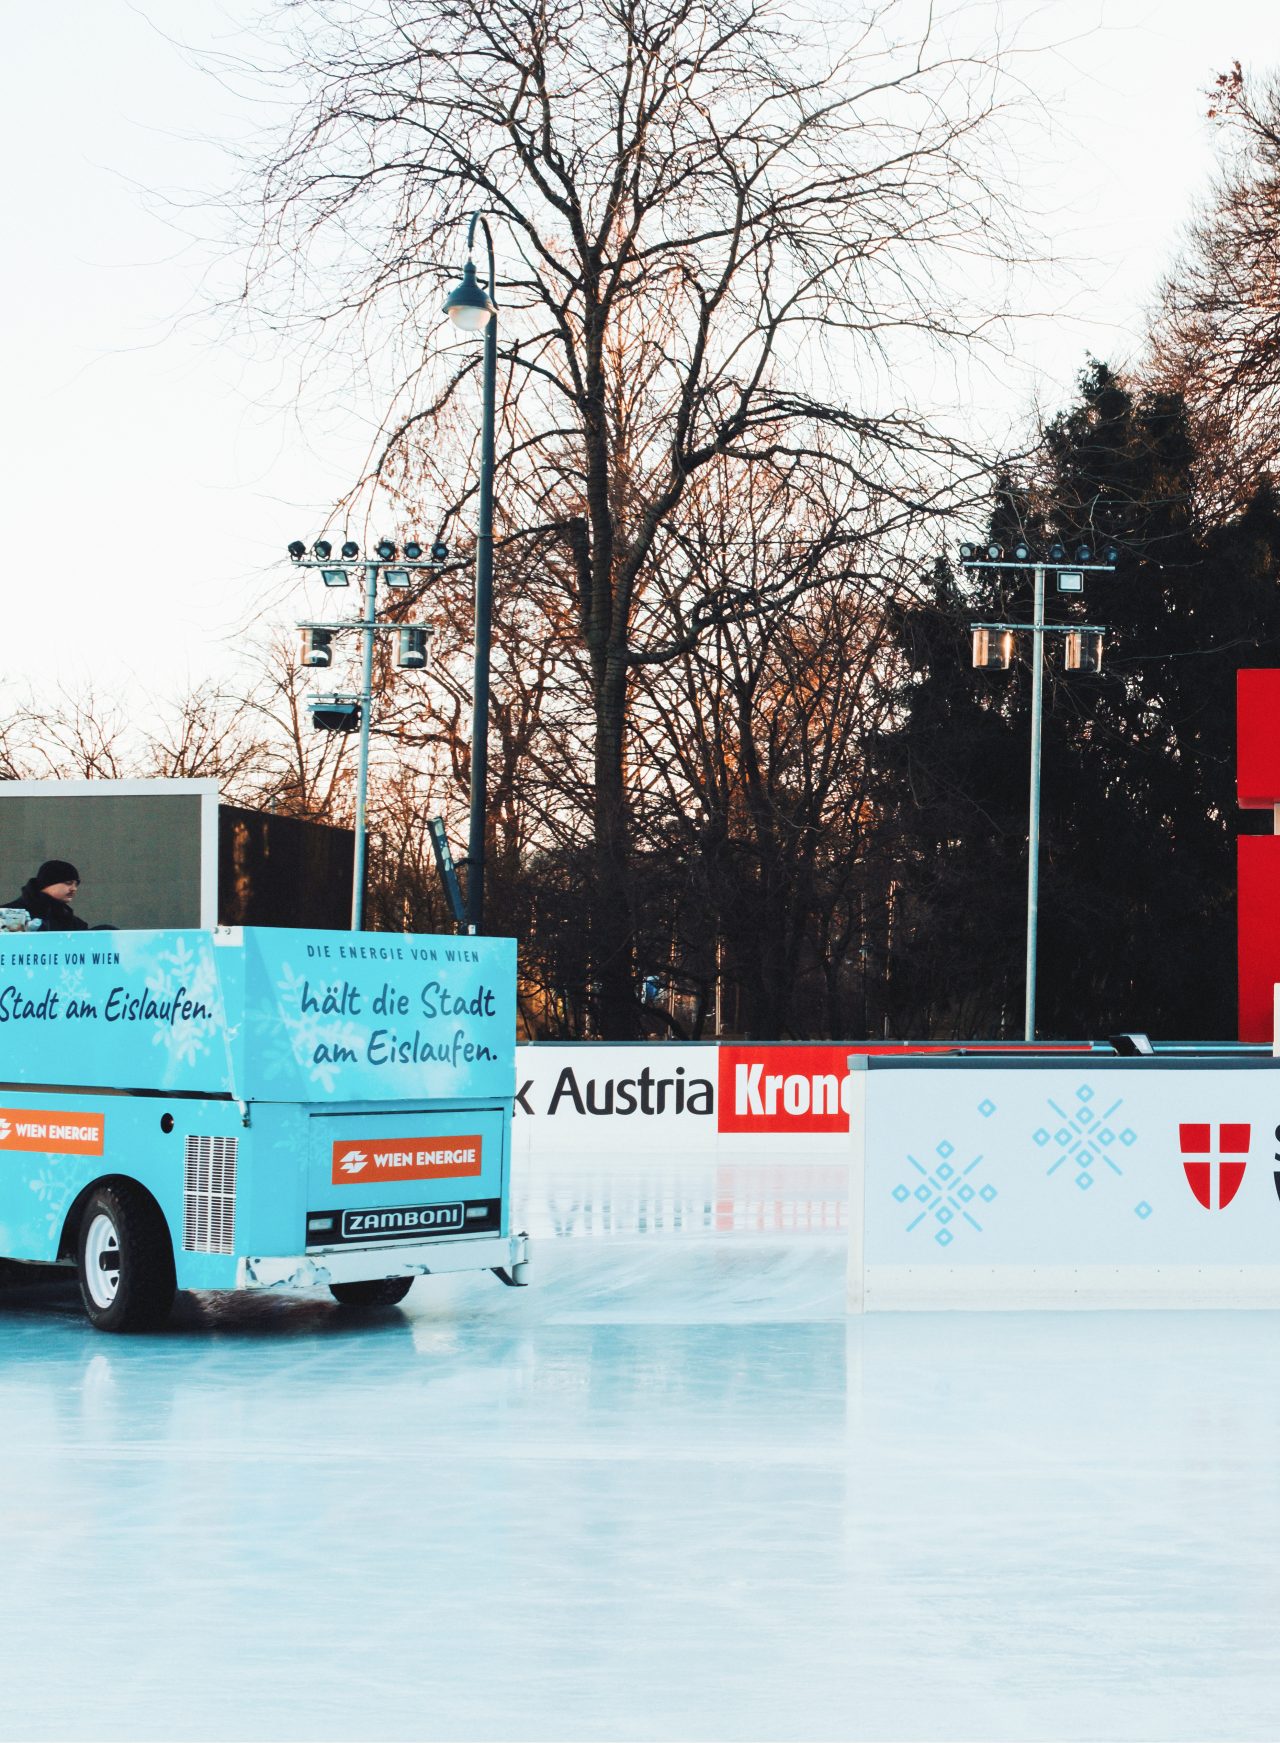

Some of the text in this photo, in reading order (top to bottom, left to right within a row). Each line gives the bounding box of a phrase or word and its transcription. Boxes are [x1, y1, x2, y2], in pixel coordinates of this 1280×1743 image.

[11, 953, 59, 965] ENERGIE
[65, 953, 85, 965] VON
[92, 952, 120, 965] WIEN
[307, 945, 480, 963] DIE ENERGIE VON WIEN
[0, 985, 213, 1026] Stadt am Eislaufen.
[301, 981, 496, 1018] hält die Stadt
[313, 1029, 498, 1068] am Eislaufen.
[547, 1066, 714, 1115] Austria
[15, 1123, 99, 1142] WIEN ENERGIE
[373, 1149, 476, 1168] WIEN ENERGIE
[350, 1208, 458, 1230] ZAMBONI
